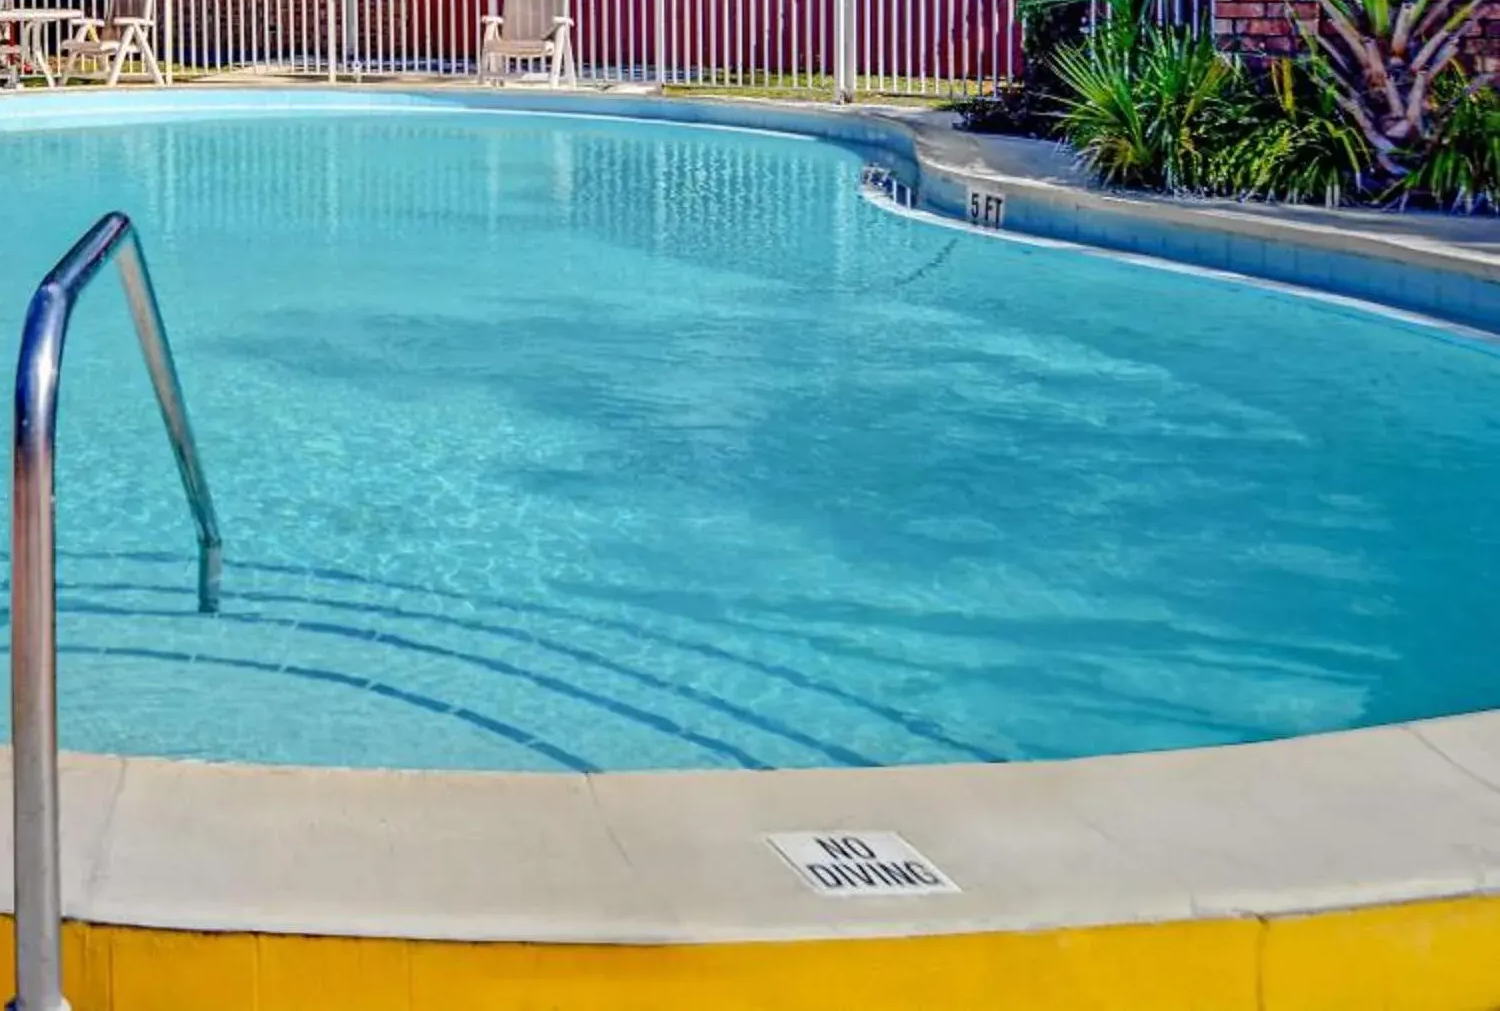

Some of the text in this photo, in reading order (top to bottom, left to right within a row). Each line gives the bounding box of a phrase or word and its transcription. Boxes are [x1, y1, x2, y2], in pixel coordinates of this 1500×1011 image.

[971, 193, 1002, 227] 5 FT
[814, 836, 876, 860] NO
[806, 861, 940, 888] DIVING
